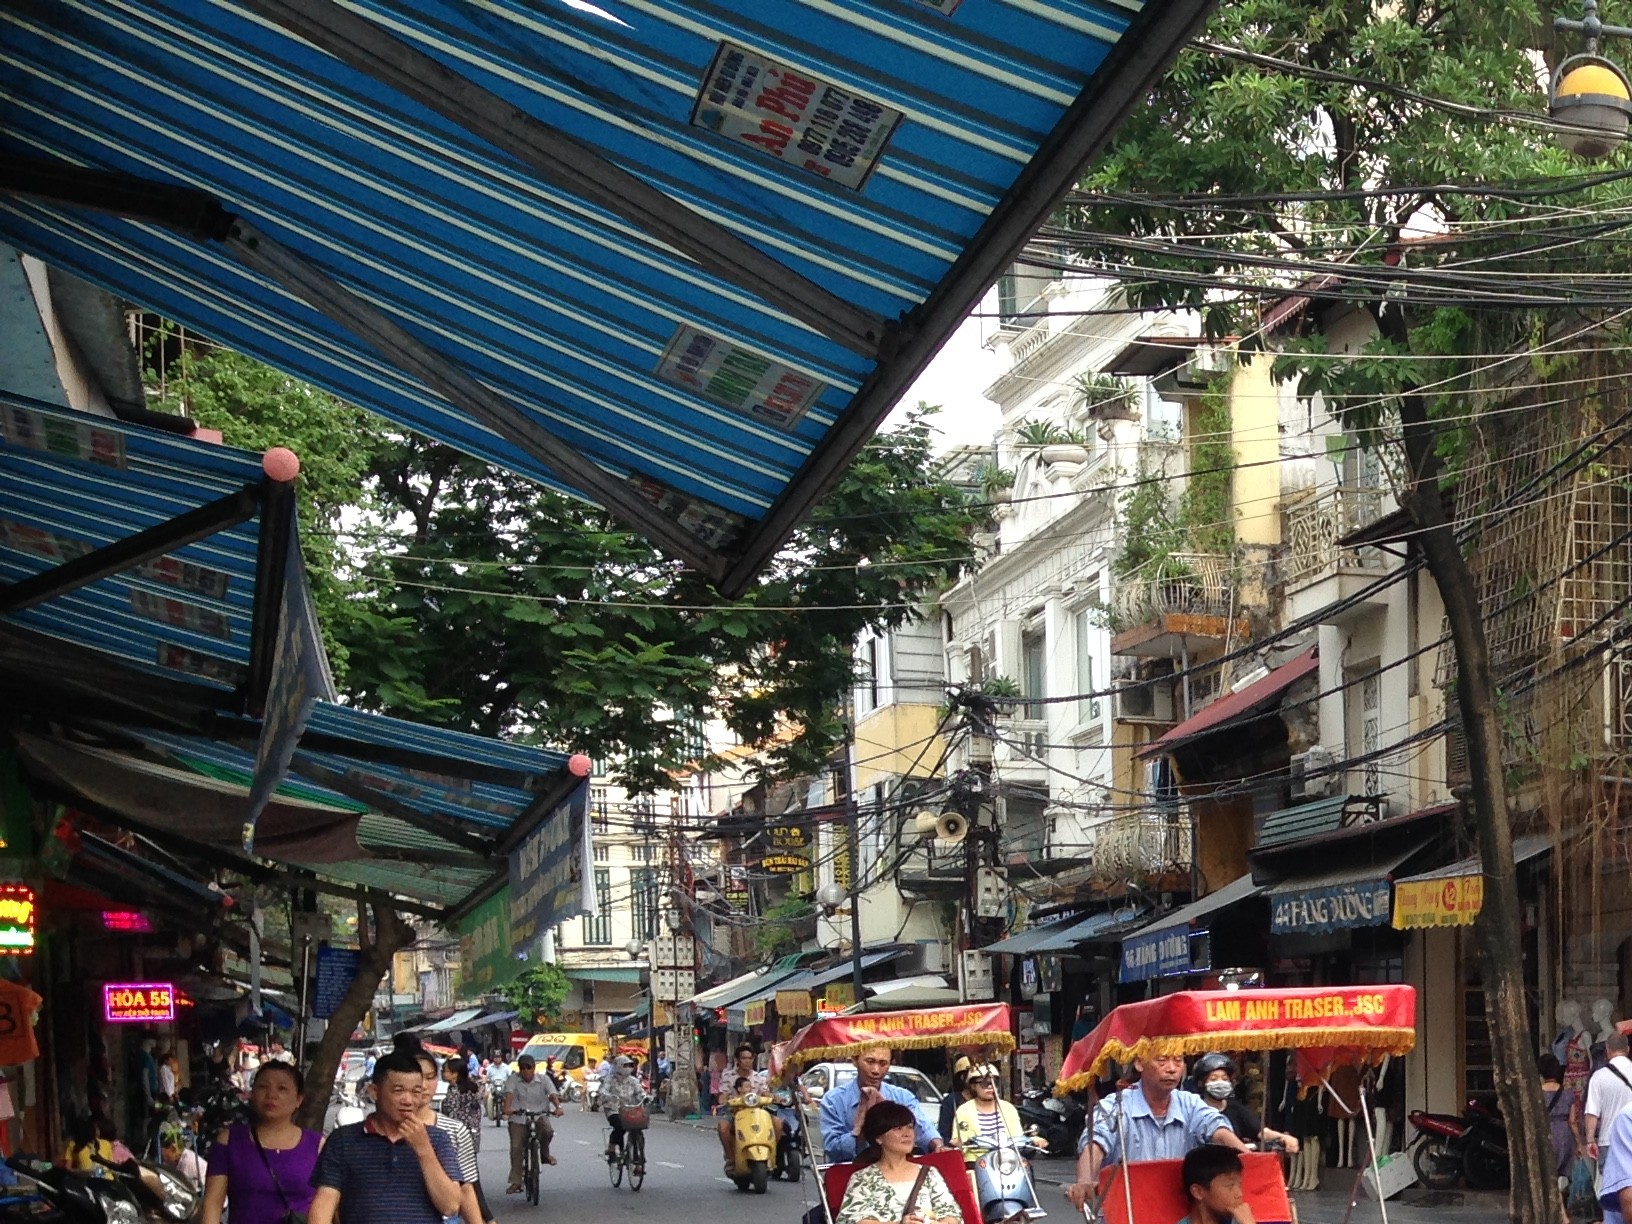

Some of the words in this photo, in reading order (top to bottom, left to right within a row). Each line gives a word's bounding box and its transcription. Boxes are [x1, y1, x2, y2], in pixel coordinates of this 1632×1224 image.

[755, 68, 817, 123] Phú
[739, 119, 794, 157] An
[150, 990, 171, 1007] 55
[1206, 1000, 1241, 1021] LAM
[1245, 998, 1279, 1021] ANH
[879, 1016, 904, 1032] ANH
